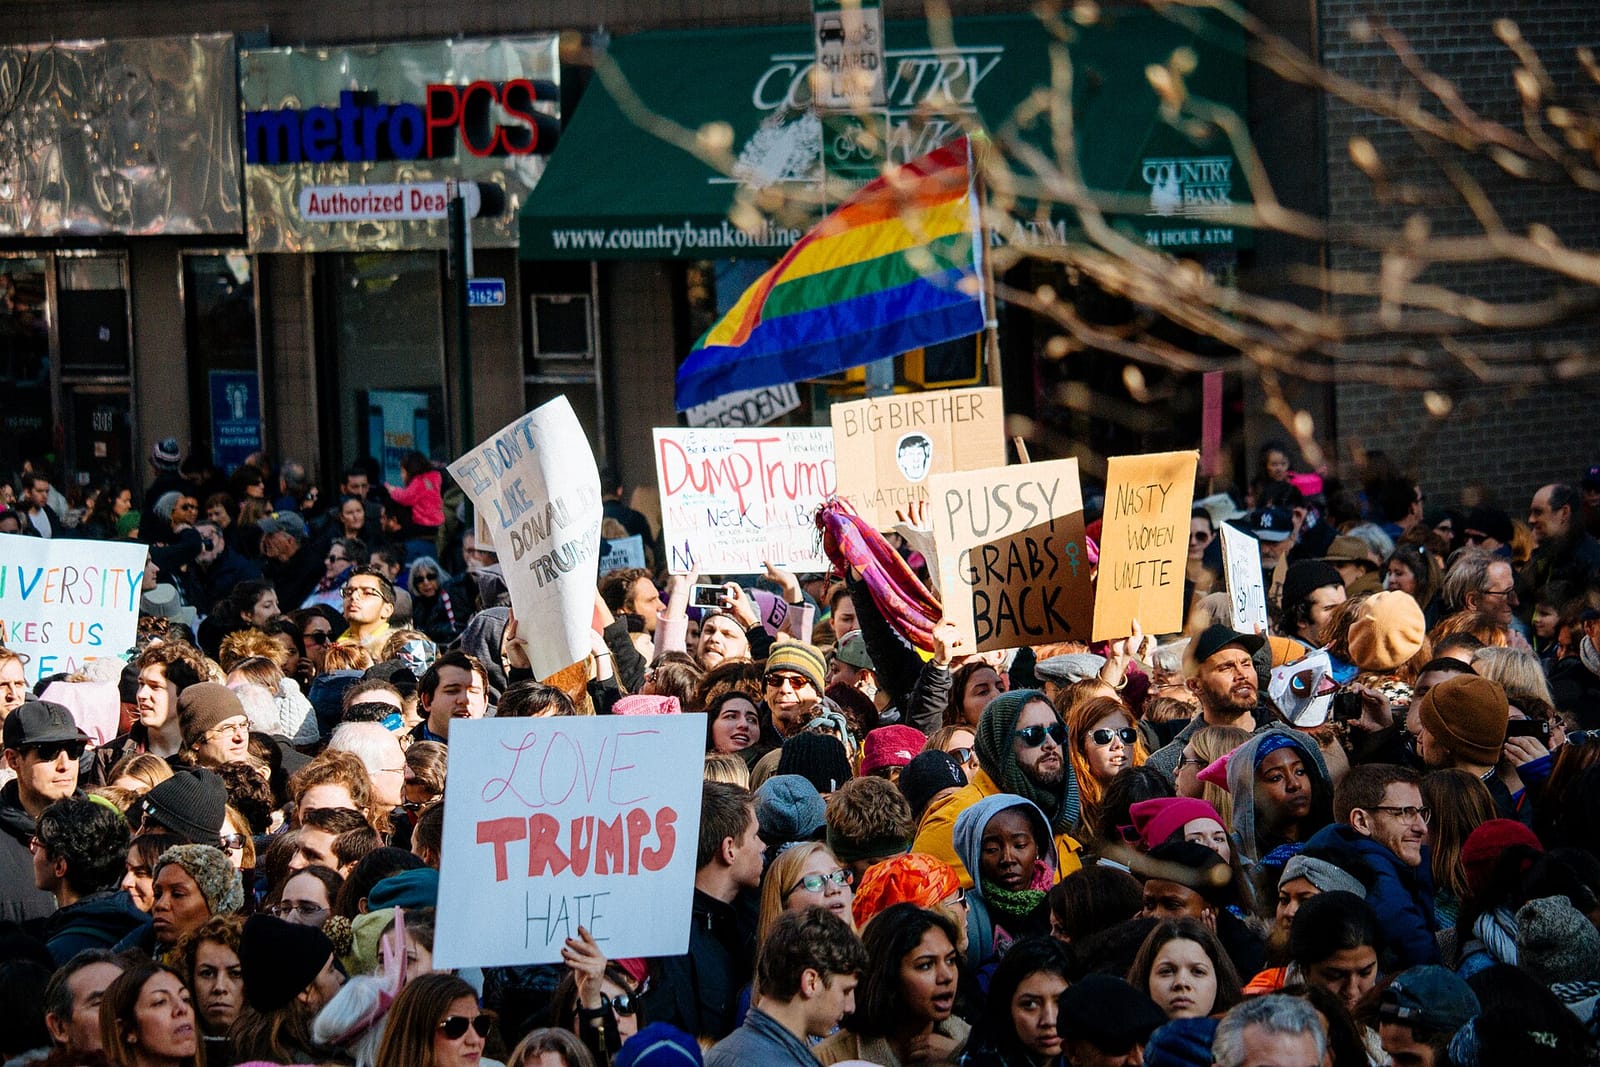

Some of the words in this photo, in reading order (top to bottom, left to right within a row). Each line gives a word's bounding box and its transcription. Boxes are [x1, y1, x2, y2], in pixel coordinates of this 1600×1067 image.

[244, 79, 539, 165] metroPCS
[1142, 162, 1233, 185] COUNTRY
[308, 190, 404, 215] Authorized
[410, 188, 447, 212] Dea
[1184, 187, 1233, 206] BANK
[1162, 229, 1201, 245] HOUR
[1203, 228, 1234, 244] ATM
[843, 404, 884, 437] BIG
[889, 393, 984, 429] BIRTHER
[457, 457, 492, 496] I
[483, 416, 536, 480] DON'T
[493, 478, 534, 529] LIKE
[863, 483, 930, 509] WATCHIN
[945, 478, 1060, 541] PUSSY
[1115, 482, 1173, 520] NASTY
[1127, 525, 1175, 551] WOMEN
[958, 536, 1059, 586] GRABS
[1114, 559, 1173, 592] UNITE
[68, 621, 104, 646] US
[972, 586, 1071, 644] BACK
[481, 730, 660, 807] LOVE
[476, 806, 678, 882] TRUMPS
[525, 890, 611, 948] HATE
